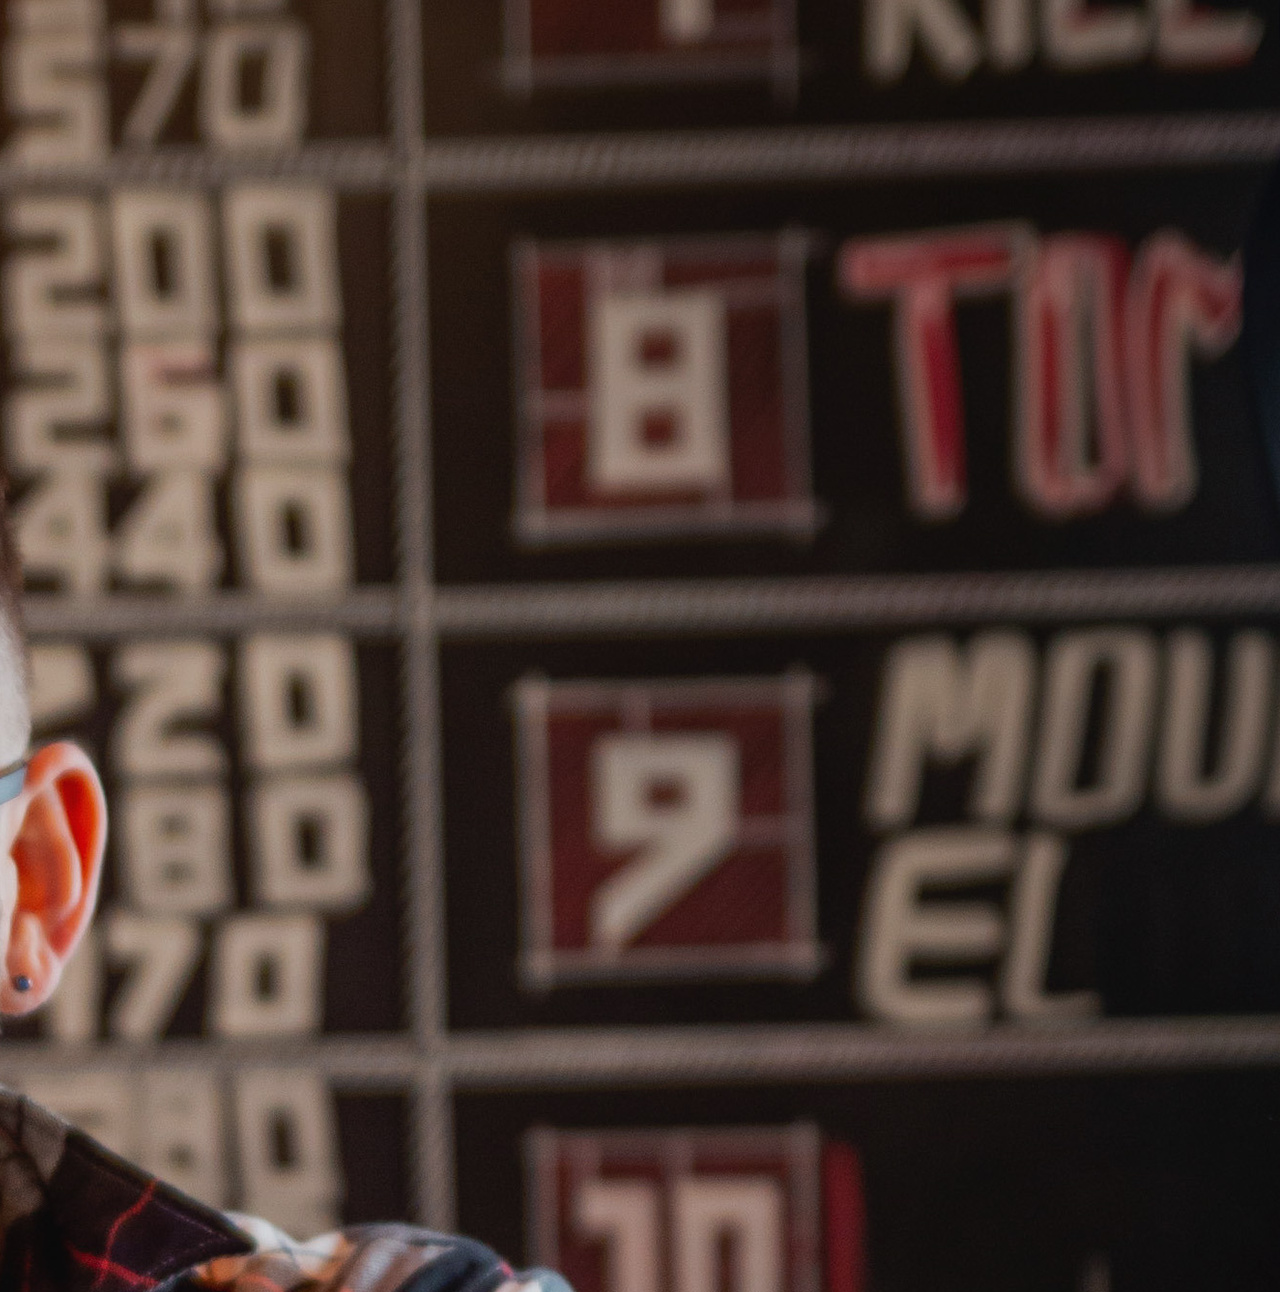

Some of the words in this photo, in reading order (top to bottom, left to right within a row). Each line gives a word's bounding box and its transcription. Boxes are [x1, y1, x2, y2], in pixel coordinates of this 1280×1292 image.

[4, 18, 312, 168] 570
[2, 184, 344, 336] 200
[586, 290, 728, 496] 8
[860, 626, 1280, 830] MOU
[586, 728, 742, 960] 9
[856, 826, 1108, 1026] EL
